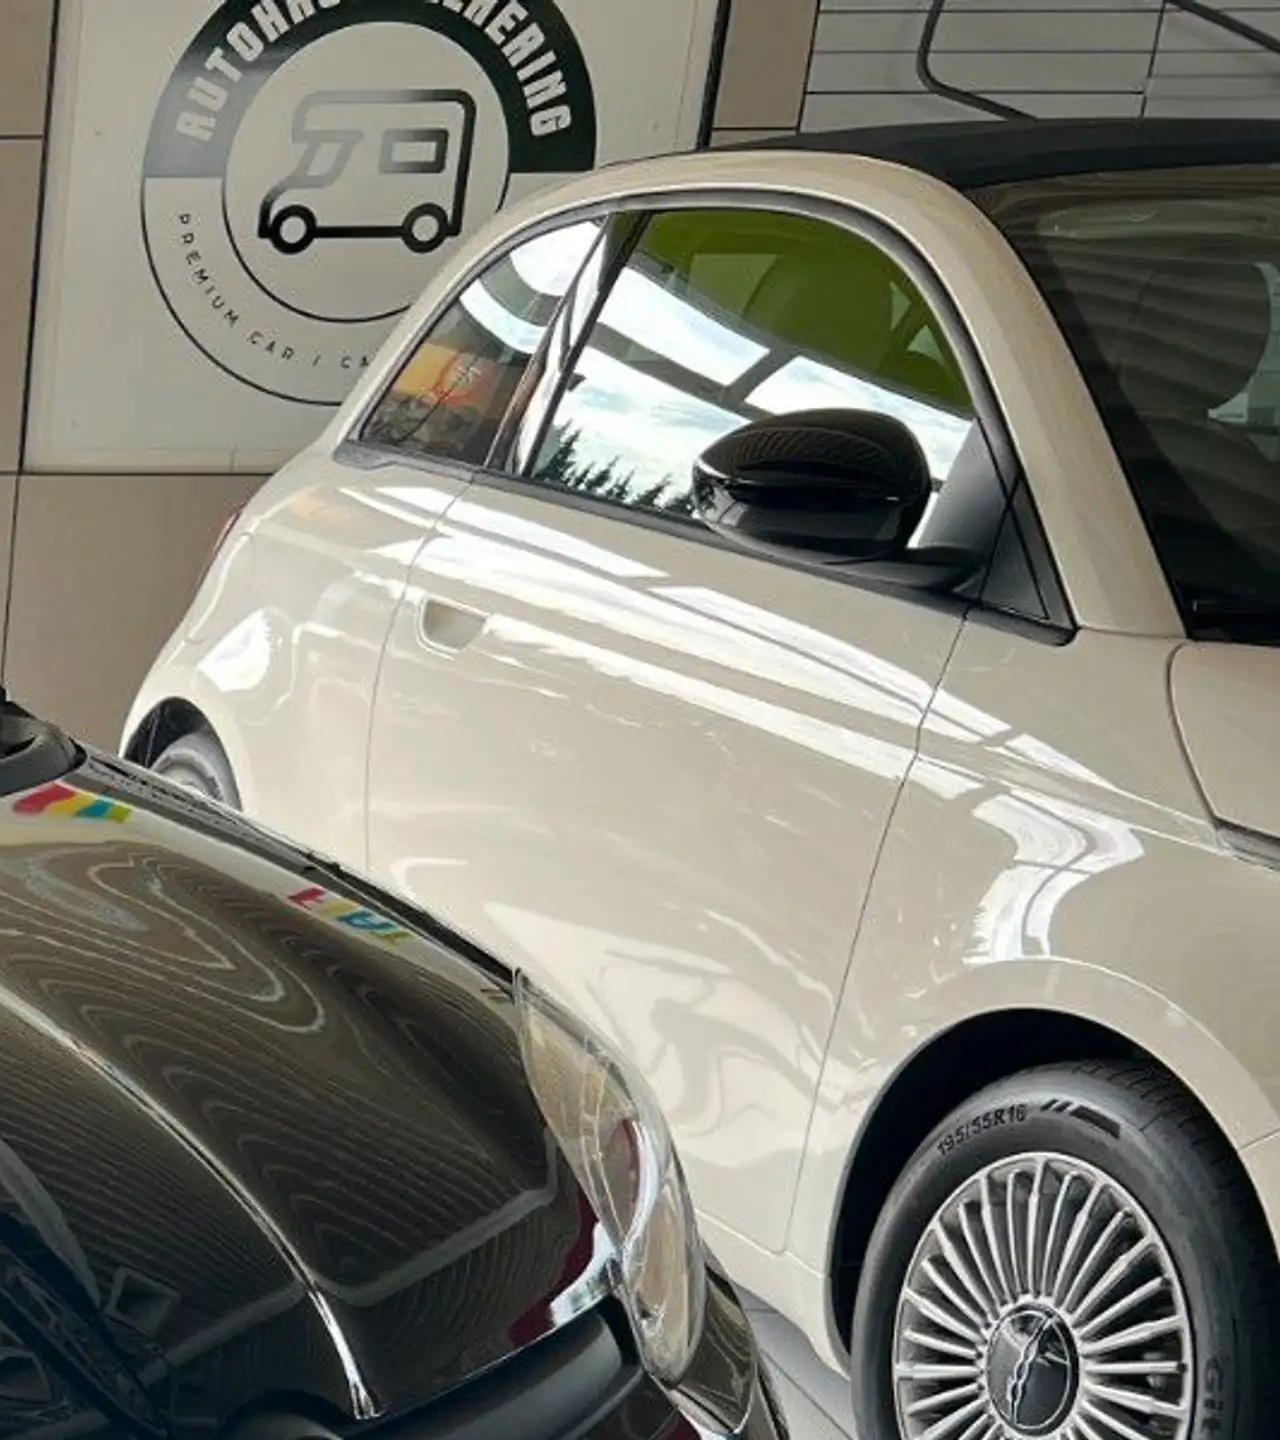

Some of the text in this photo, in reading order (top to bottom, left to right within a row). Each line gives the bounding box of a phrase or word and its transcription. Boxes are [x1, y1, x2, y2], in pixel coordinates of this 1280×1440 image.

[175, 0, 342, 142] AUTOHA
[179, 213, 241, 328] PREMIUM
[247, 330, 295, 361] CAR
[340, 355, 371, 369] CA
[937, 1103, 1029, 1156] 195/55R16
